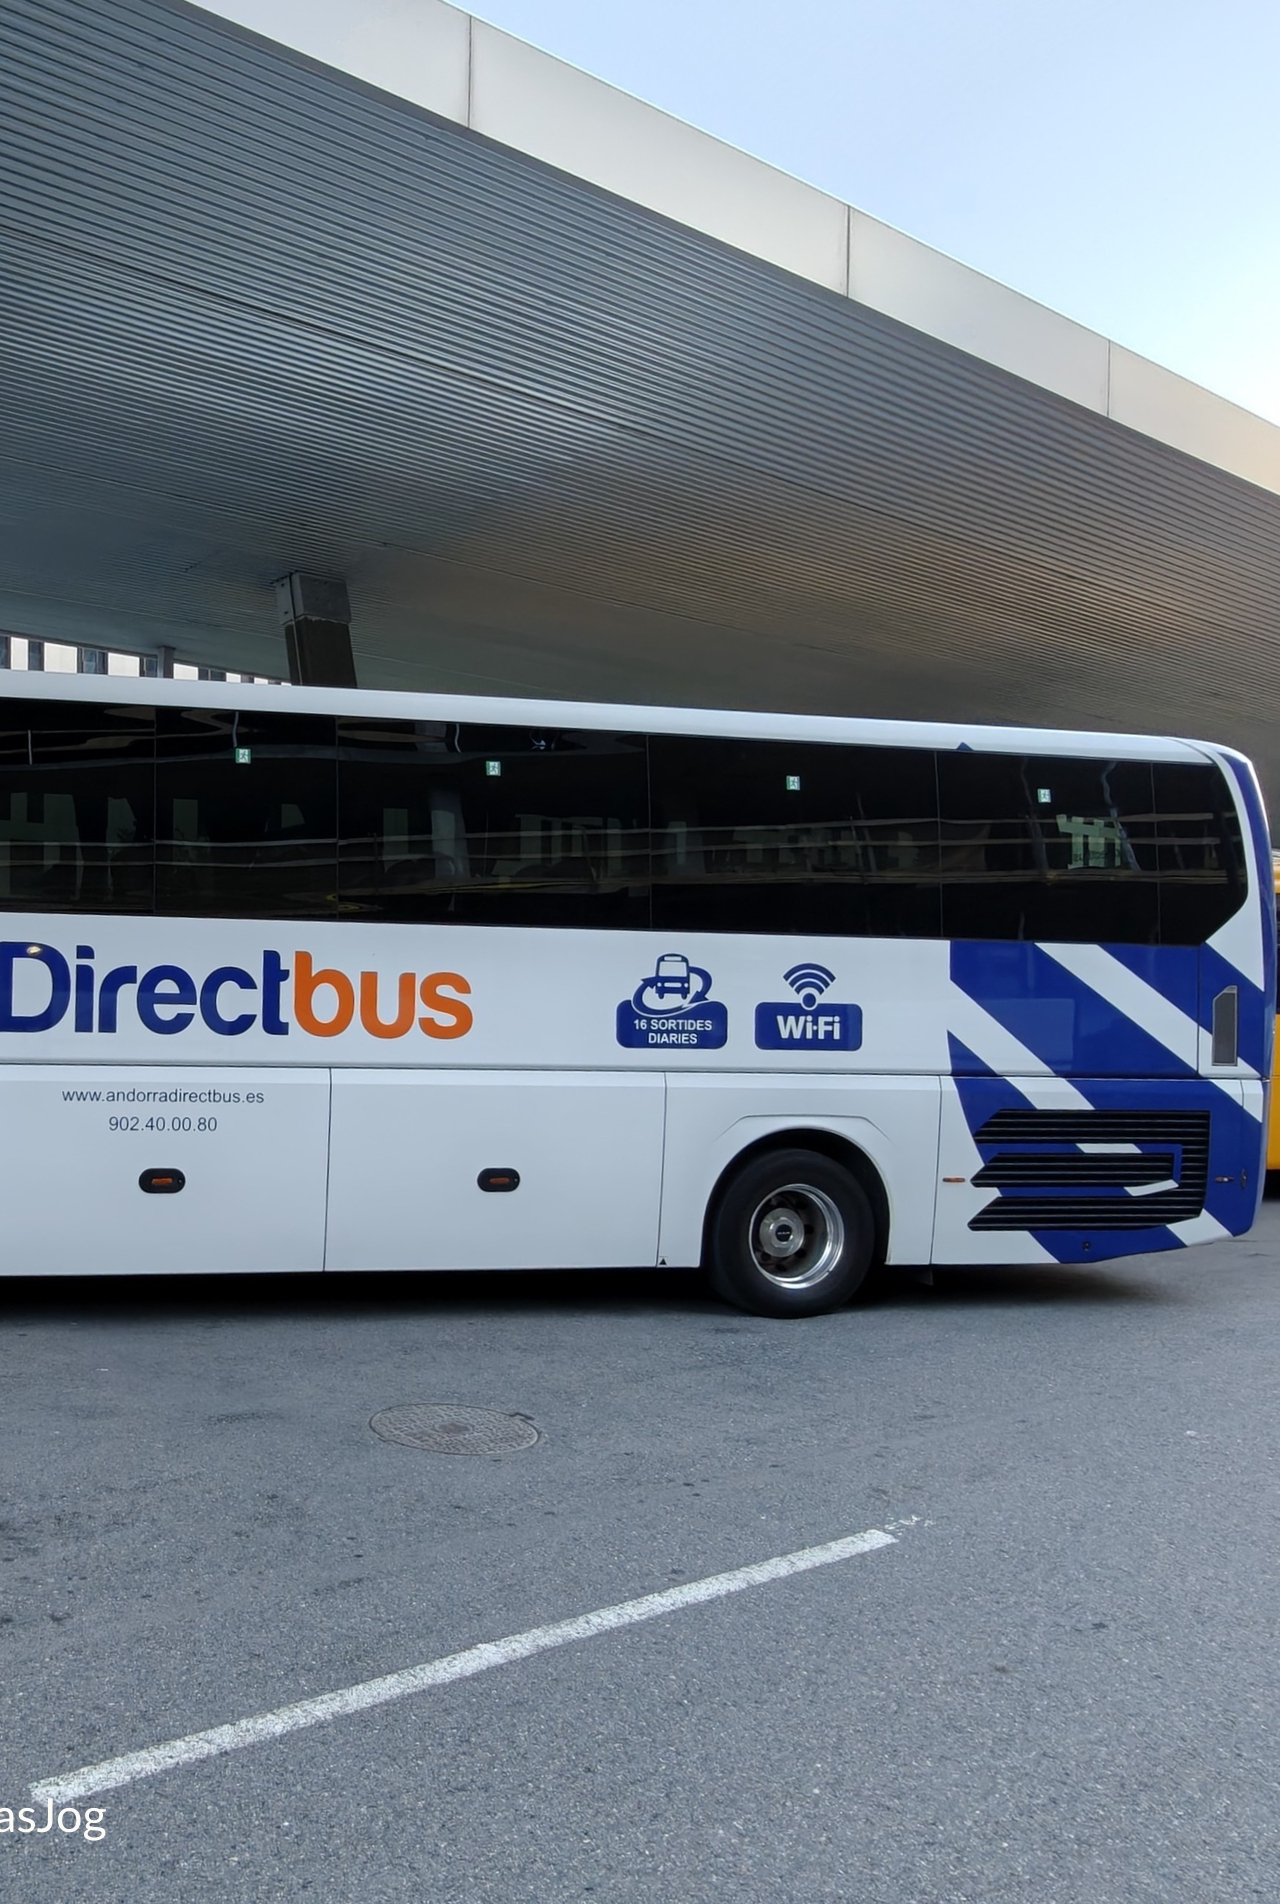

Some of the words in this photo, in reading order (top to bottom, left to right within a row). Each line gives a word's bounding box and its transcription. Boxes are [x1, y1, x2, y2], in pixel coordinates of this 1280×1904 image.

[634, 1019, 648, 1031] 16
[651, 1019, 713, 1032] SORTIDES
[648, 1033, 698, 1045] DIARIES
[61, 1088, 265, 1104] www.andorradirectbus.es
[108, 1116, 218, 1132] 902.40.00.80
